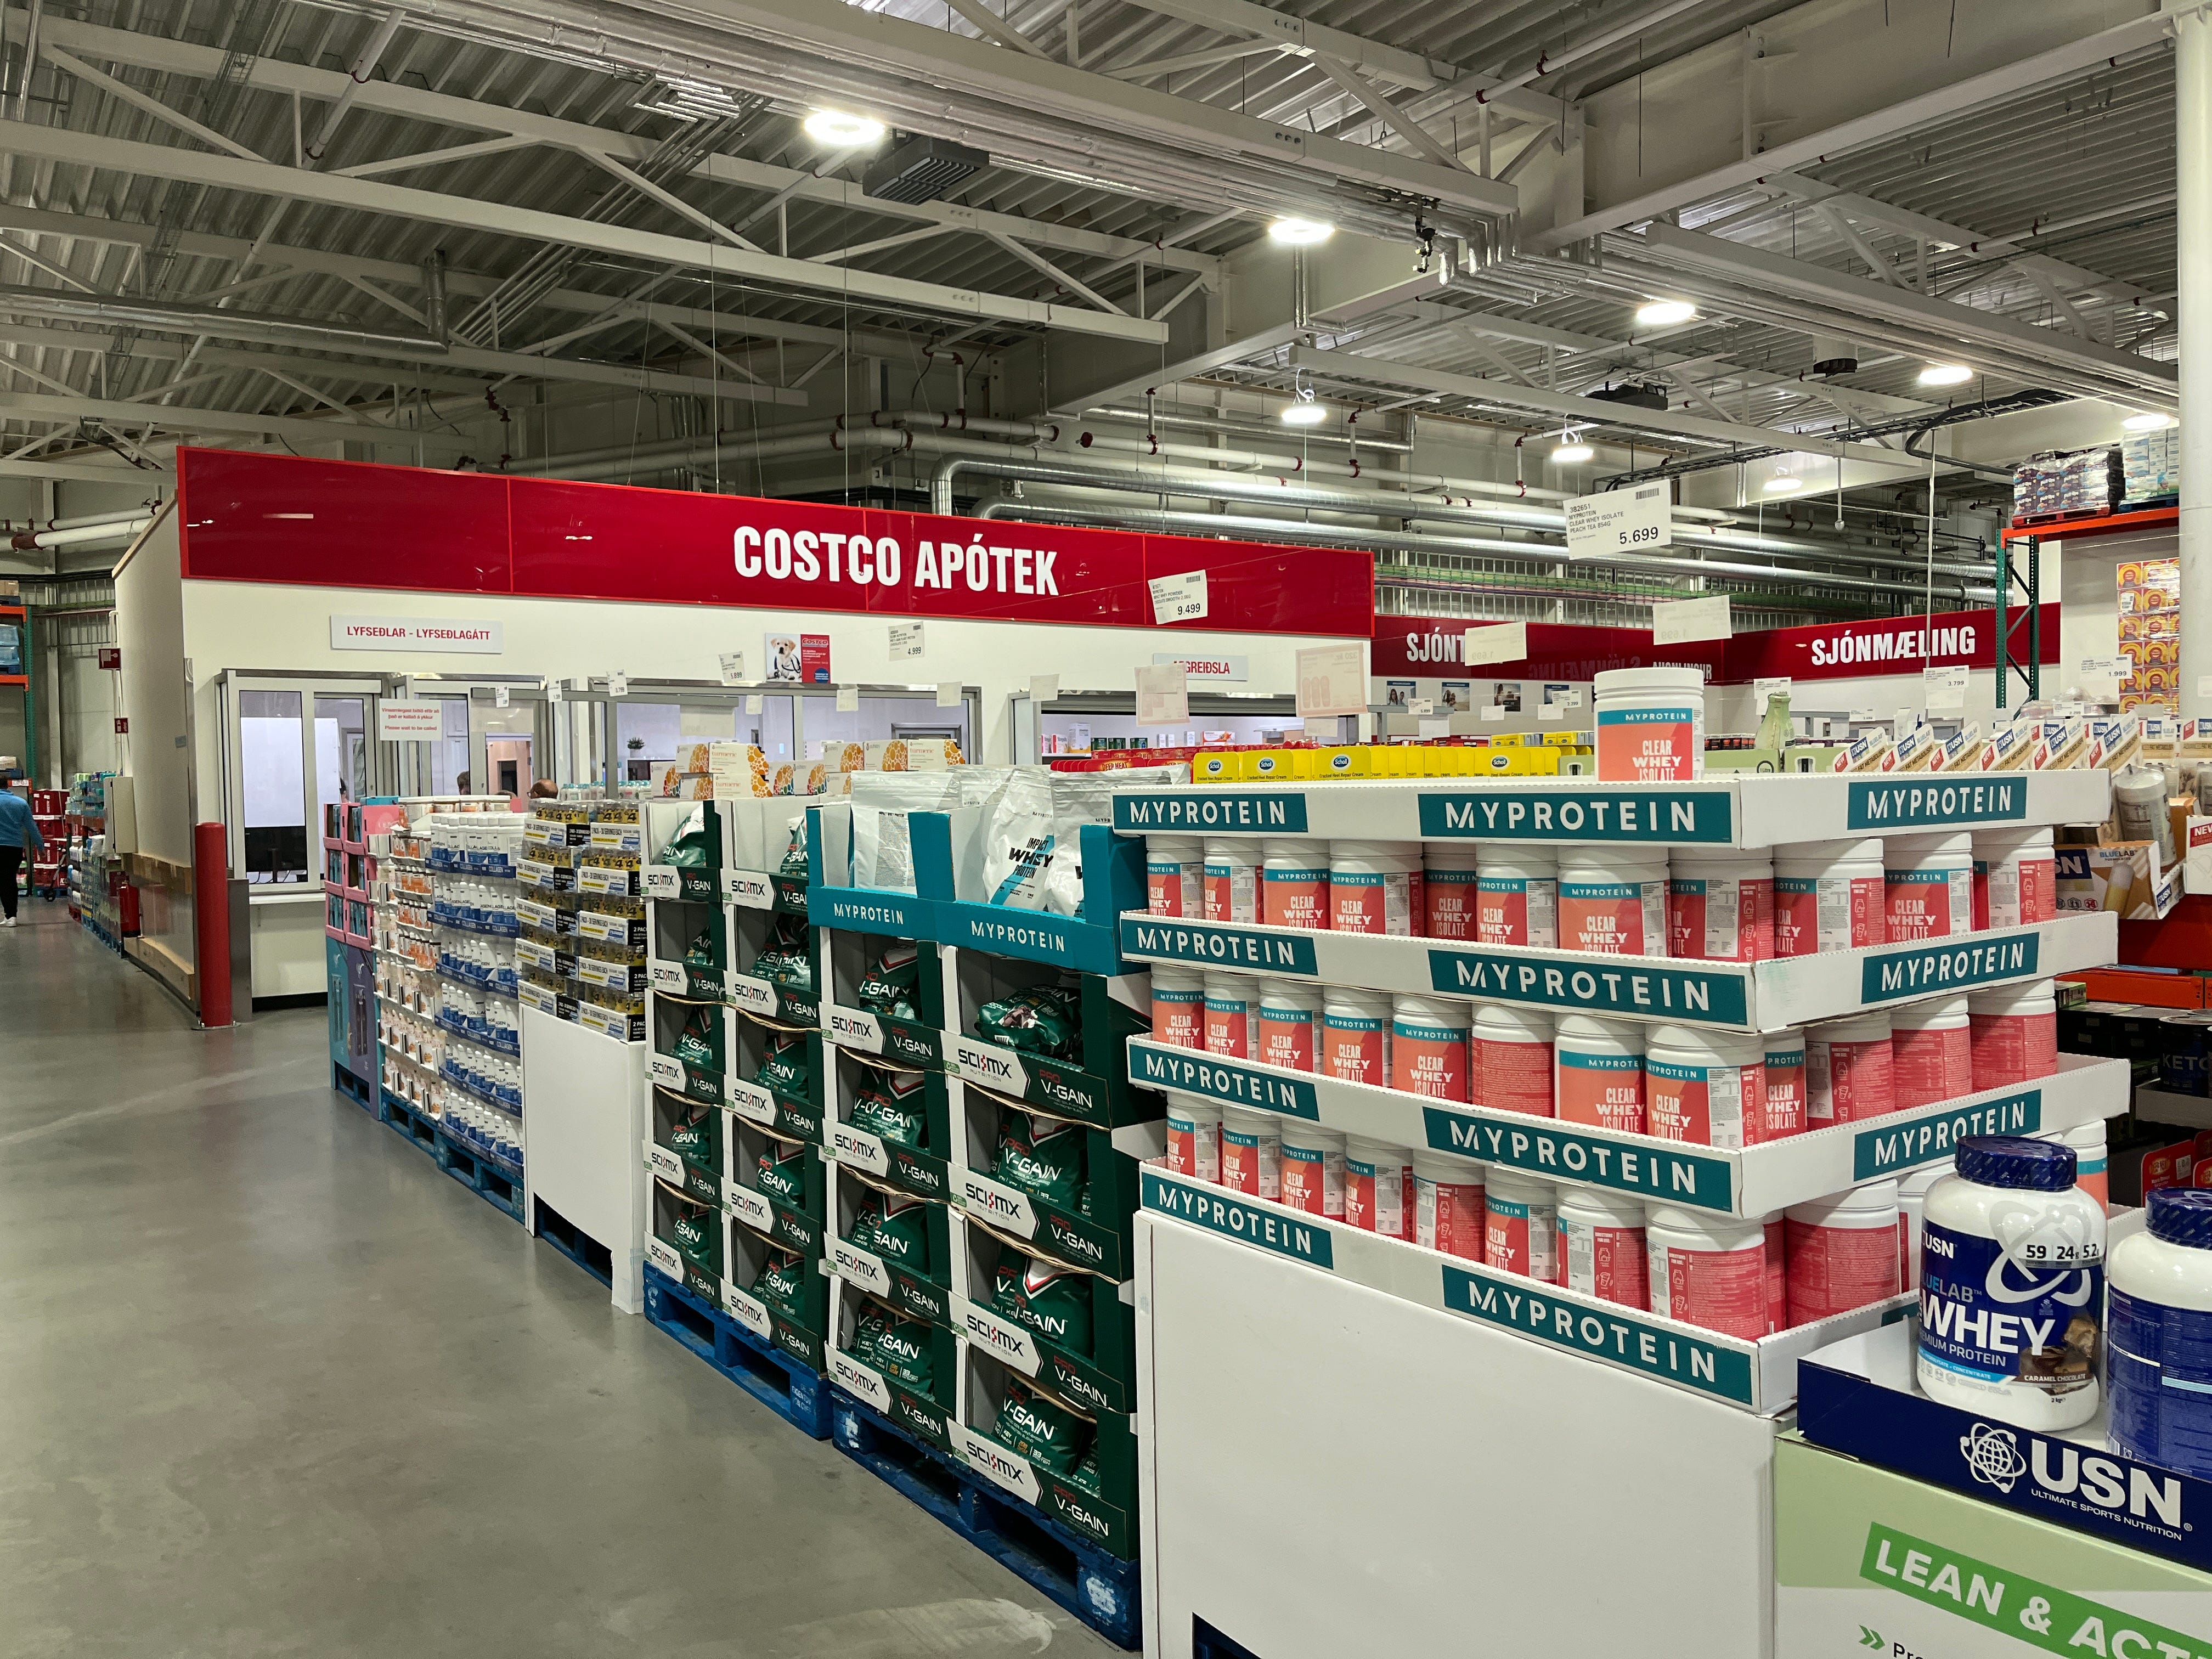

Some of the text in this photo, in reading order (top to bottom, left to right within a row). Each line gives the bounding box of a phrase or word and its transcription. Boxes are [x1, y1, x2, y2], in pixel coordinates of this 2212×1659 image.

[1568, 510, 1596, 520] MYPROTEIN
[1570, 504, 1590, 513] 382651
[1601, 511, 1624, 520] ISOLATE
[1620, 527, 1658, 544] 5.699
[733, 525, 1059, 596] COSTCO APÓTEK
[1178, 603, 1200, 615] 9.499
[347, 626, 405, 637] LYFSEÐLAR
[416, 629, 490, 640] LYFSEÐLAGÁTT
[908, 647, 921, 655] 4.999
[1811, 626, 1976, 666] SJÓNMÆLING
[1174, 661, 1230, 674] GREIÐSLA
[1625, 712, 1686, 721] MYPROTEIN
[1642, 740, 1672, 755] CLEAR
[1101, 761, 1114, 771] DEEP
[1632, 756, 1681, 768] WHEY
[1130, 800, 1285, 824] MYPROTEIN
[1867, 786, 2012, 819] MYPROTEIN
[1446, 801, 1695, 832] MYPROTEIN
[1026, 837, 1049, 851] IMPACT
[1009, 847, 1054, 868] WHEY
[2055, 855, 2083, 874] SN
[1013, 865, 1037, 879] PROTEIN
[687, 879, 711, 891] V-GAIN
[1571, 888, 1632, 896] MYPROTEIN
[783, 891, 808, 904] V-GAI
[1290, 895, 1314, 909] CLEAR
[1341, 900, 1362, 915] CLEAR
[1895, 900, 1925, 914] CLEAR
[834, 903, 904, 924] MYPROTEIN
[1283, 909, 1323, 919] WHEY
[1886, 915, 1936, 926] WHEY
[1436, 922, 1466, 936] ISOLATE
[1585, 916, 1616, 932] CLEAR
[971, 921, 1065, 952] MYPROTEIN
[1578, 932, 1627, 944] WHEY
[1138, 928, 1295, 966] MYPROTEIN
[1881, 942, 2024, 991] MYPROTEIN
[693, 980, 719, 991] V-GAIN
[1456, 960, 1709, 1012] MYPROTEIN
[786, 1000, 817, 1018] V-GAIN
[1170, 1015, 1192, 1027] CLEAR
[1406, 1030, 1459, 1040] MYPROTEIN
[893, 1035, 933, 1057] V-GAIN
[692, 1078, 717, 1094] V-GAIN
[1146, 1054, 1297, 1108] MYPROTEIN
[1041, 1079, 1092, 1109] V-GAIN
[784, 1110, 814, 1131] V-GAIN
[1766, 1113, 1797, 1130] ISOLATE
[1004, 1148, 1060, 1181] V-GAIN
[1450, 1120, 1696, 1194] MYPROTEIN
[899, 1161, 939, 1187] V-GAIN
[691, 1175, 715, 1196] V-GAIN
[1159, 1184, 1311, 1255] MYPROTEIN
[782, 1219, 810, 1243] V-GAIN
[1051, 1223, 1102, 1260] V-GAIN
[1925, 1233, 1954, 1259] USN
[2026, 1245, 2046, 1259] 59
[690, 1272, 714, 1296] V-GAIN
[900, 1283, 940, 1314] V-GAIN
[1469, 1281, 1715, 1384] MYPROTEIN
[1922, 1289, 2056, 1356] WHEY
[779, 1328, 809, 1356] V-GAIN
[1949, 1344, 2006, 1367] PROTEIN
[1953, 1365, 1991, 1380] CONCENTRATE
[1055, 1365, 1107, 1407] V-GAIN
[900, 1401, 941, 1436] V-GAIN
[1004, 1396, 1054, 1440] V-GAIN
[1003, 1429, 1012, 1438] KEY
[1033, 1449, 1042, 1458] 33
[2032, 1438, 2181, 1528] USN
[1055, 1494, 1109, 1537] V-GAIN
[2031, 1488, 2182, 1541] ULTIMATE SPORTS NUTRITION
[1875, 1539, 2212, 1659] LEAN & ACT
